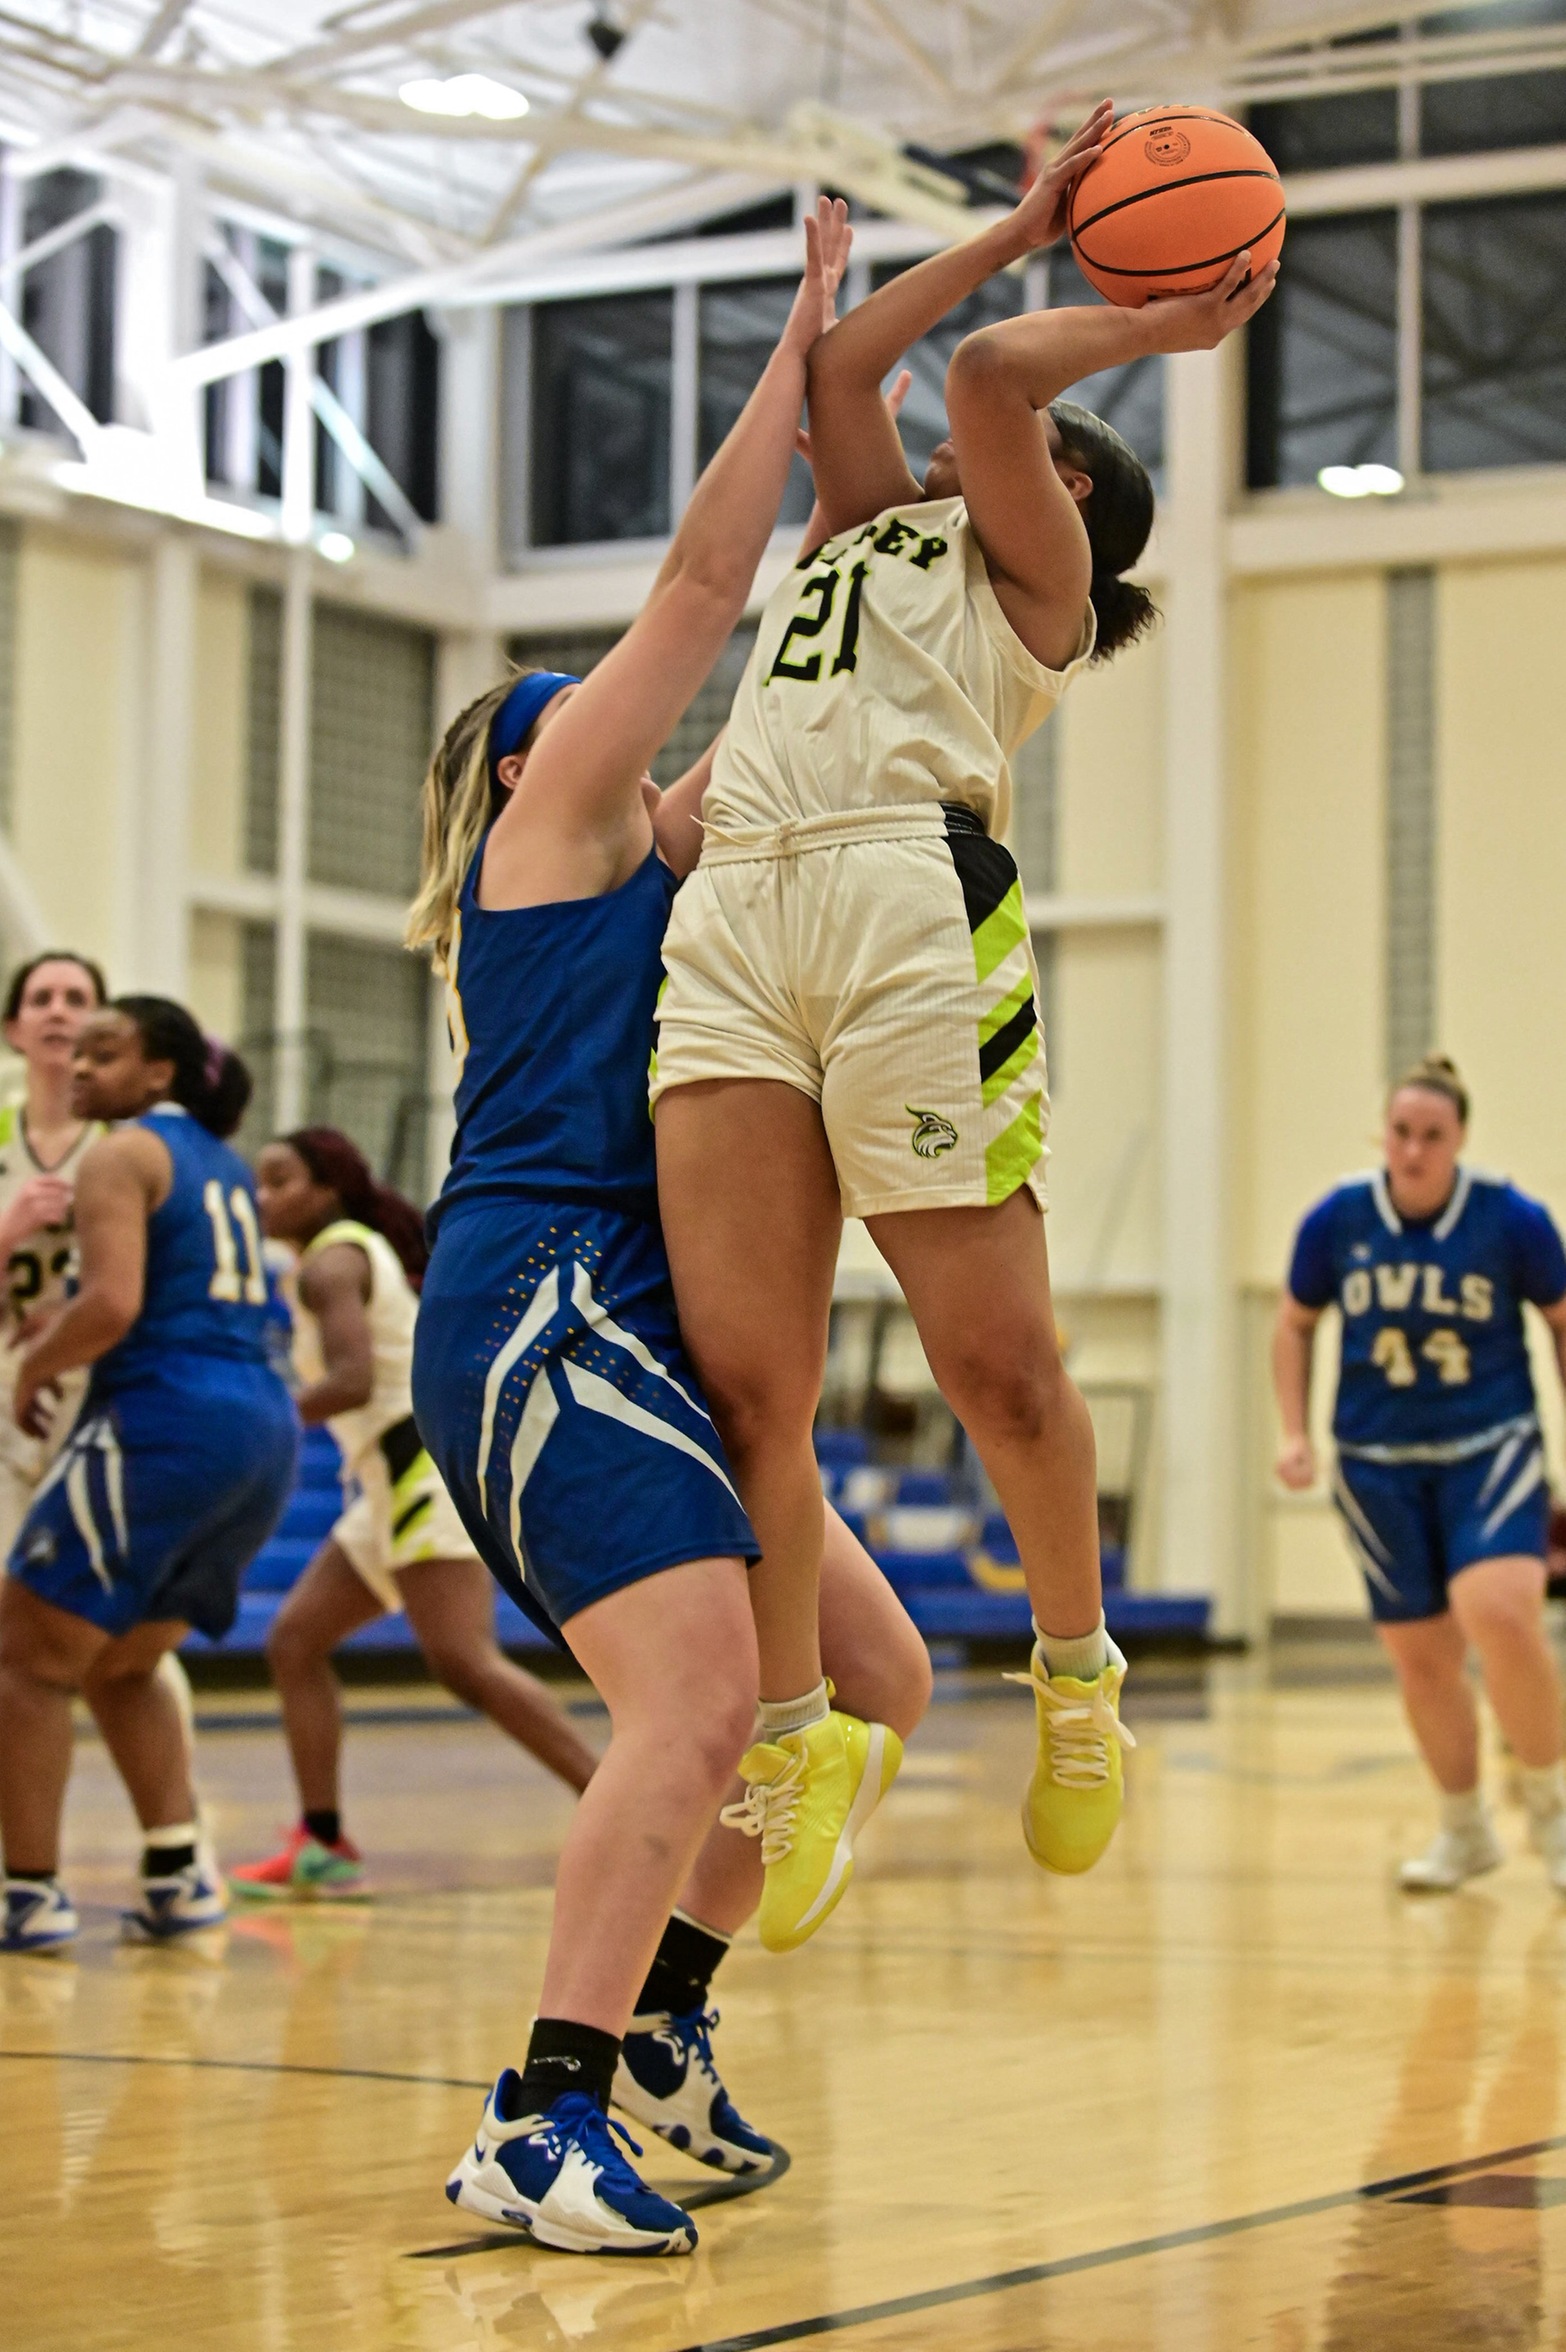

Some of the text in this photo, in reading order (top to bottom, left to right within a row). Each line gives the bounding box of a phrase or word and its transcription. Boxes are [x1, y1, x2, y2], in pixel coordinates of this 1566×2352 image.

[763, 560, 871, 687] 21
[203, 1179, 268, 1304] 11
[1342, 1263, 1493, 1321] OWLS
